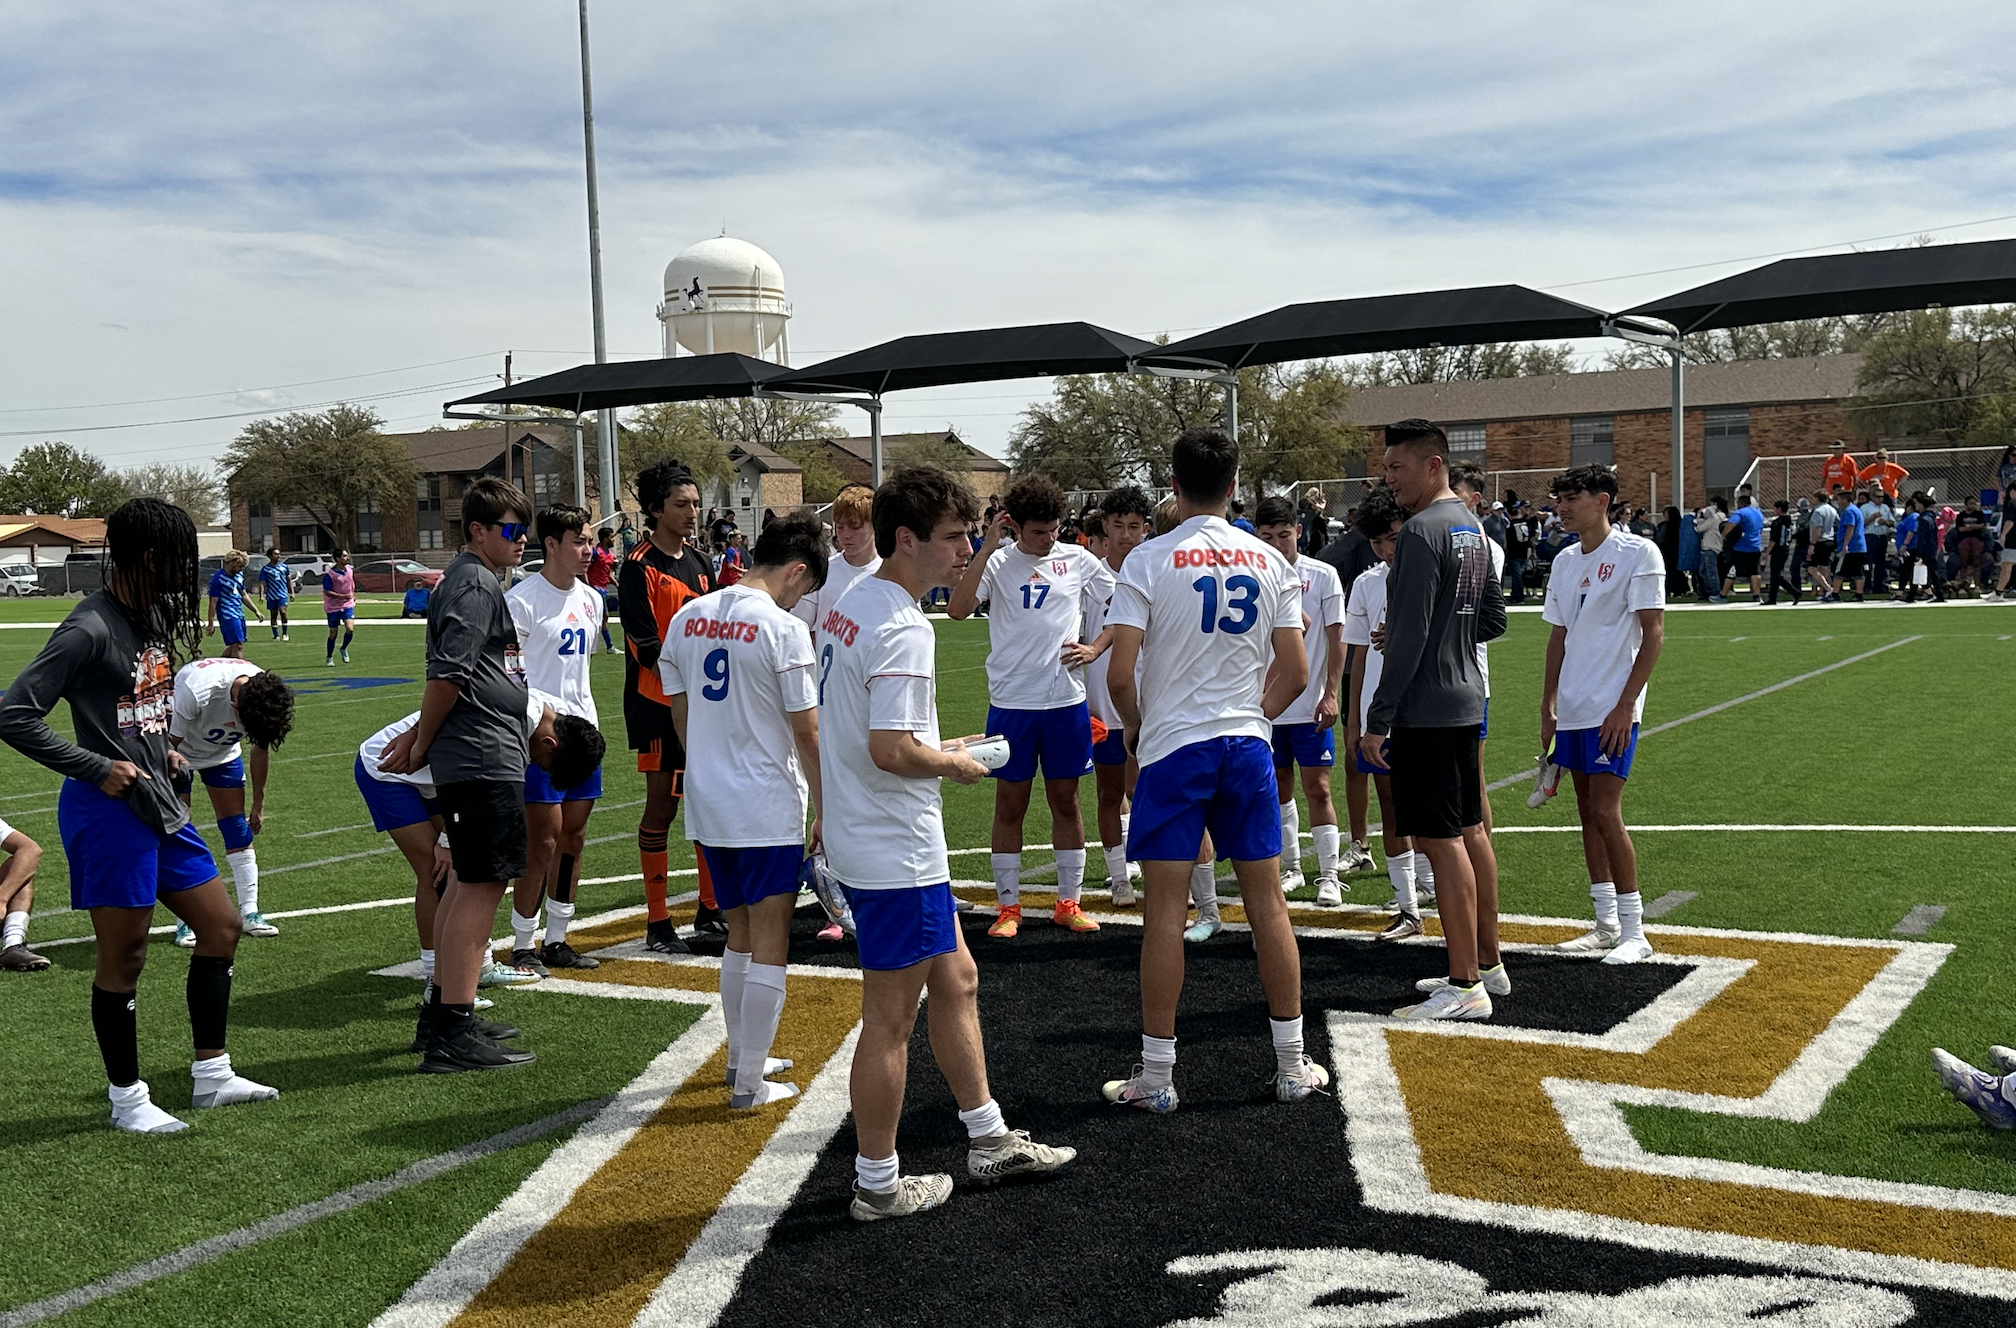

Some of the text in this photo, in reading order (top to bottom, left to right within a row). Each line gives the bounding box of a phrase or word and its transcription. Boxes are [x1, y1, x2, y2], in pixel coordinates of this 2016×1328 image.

[1173, 548, 1268, 570] BOBCATS
[1020, 584, 1051, 609] 17
[1192, 574, 1260, 634] 13
[684, 617, 759, 643] BOBCATS
[822, 609, 860, 647] OBCATS
[558, 628, 585, 655] 21
[702, 648, 730, 701] 9
[202, 728, 244, 746] 23
